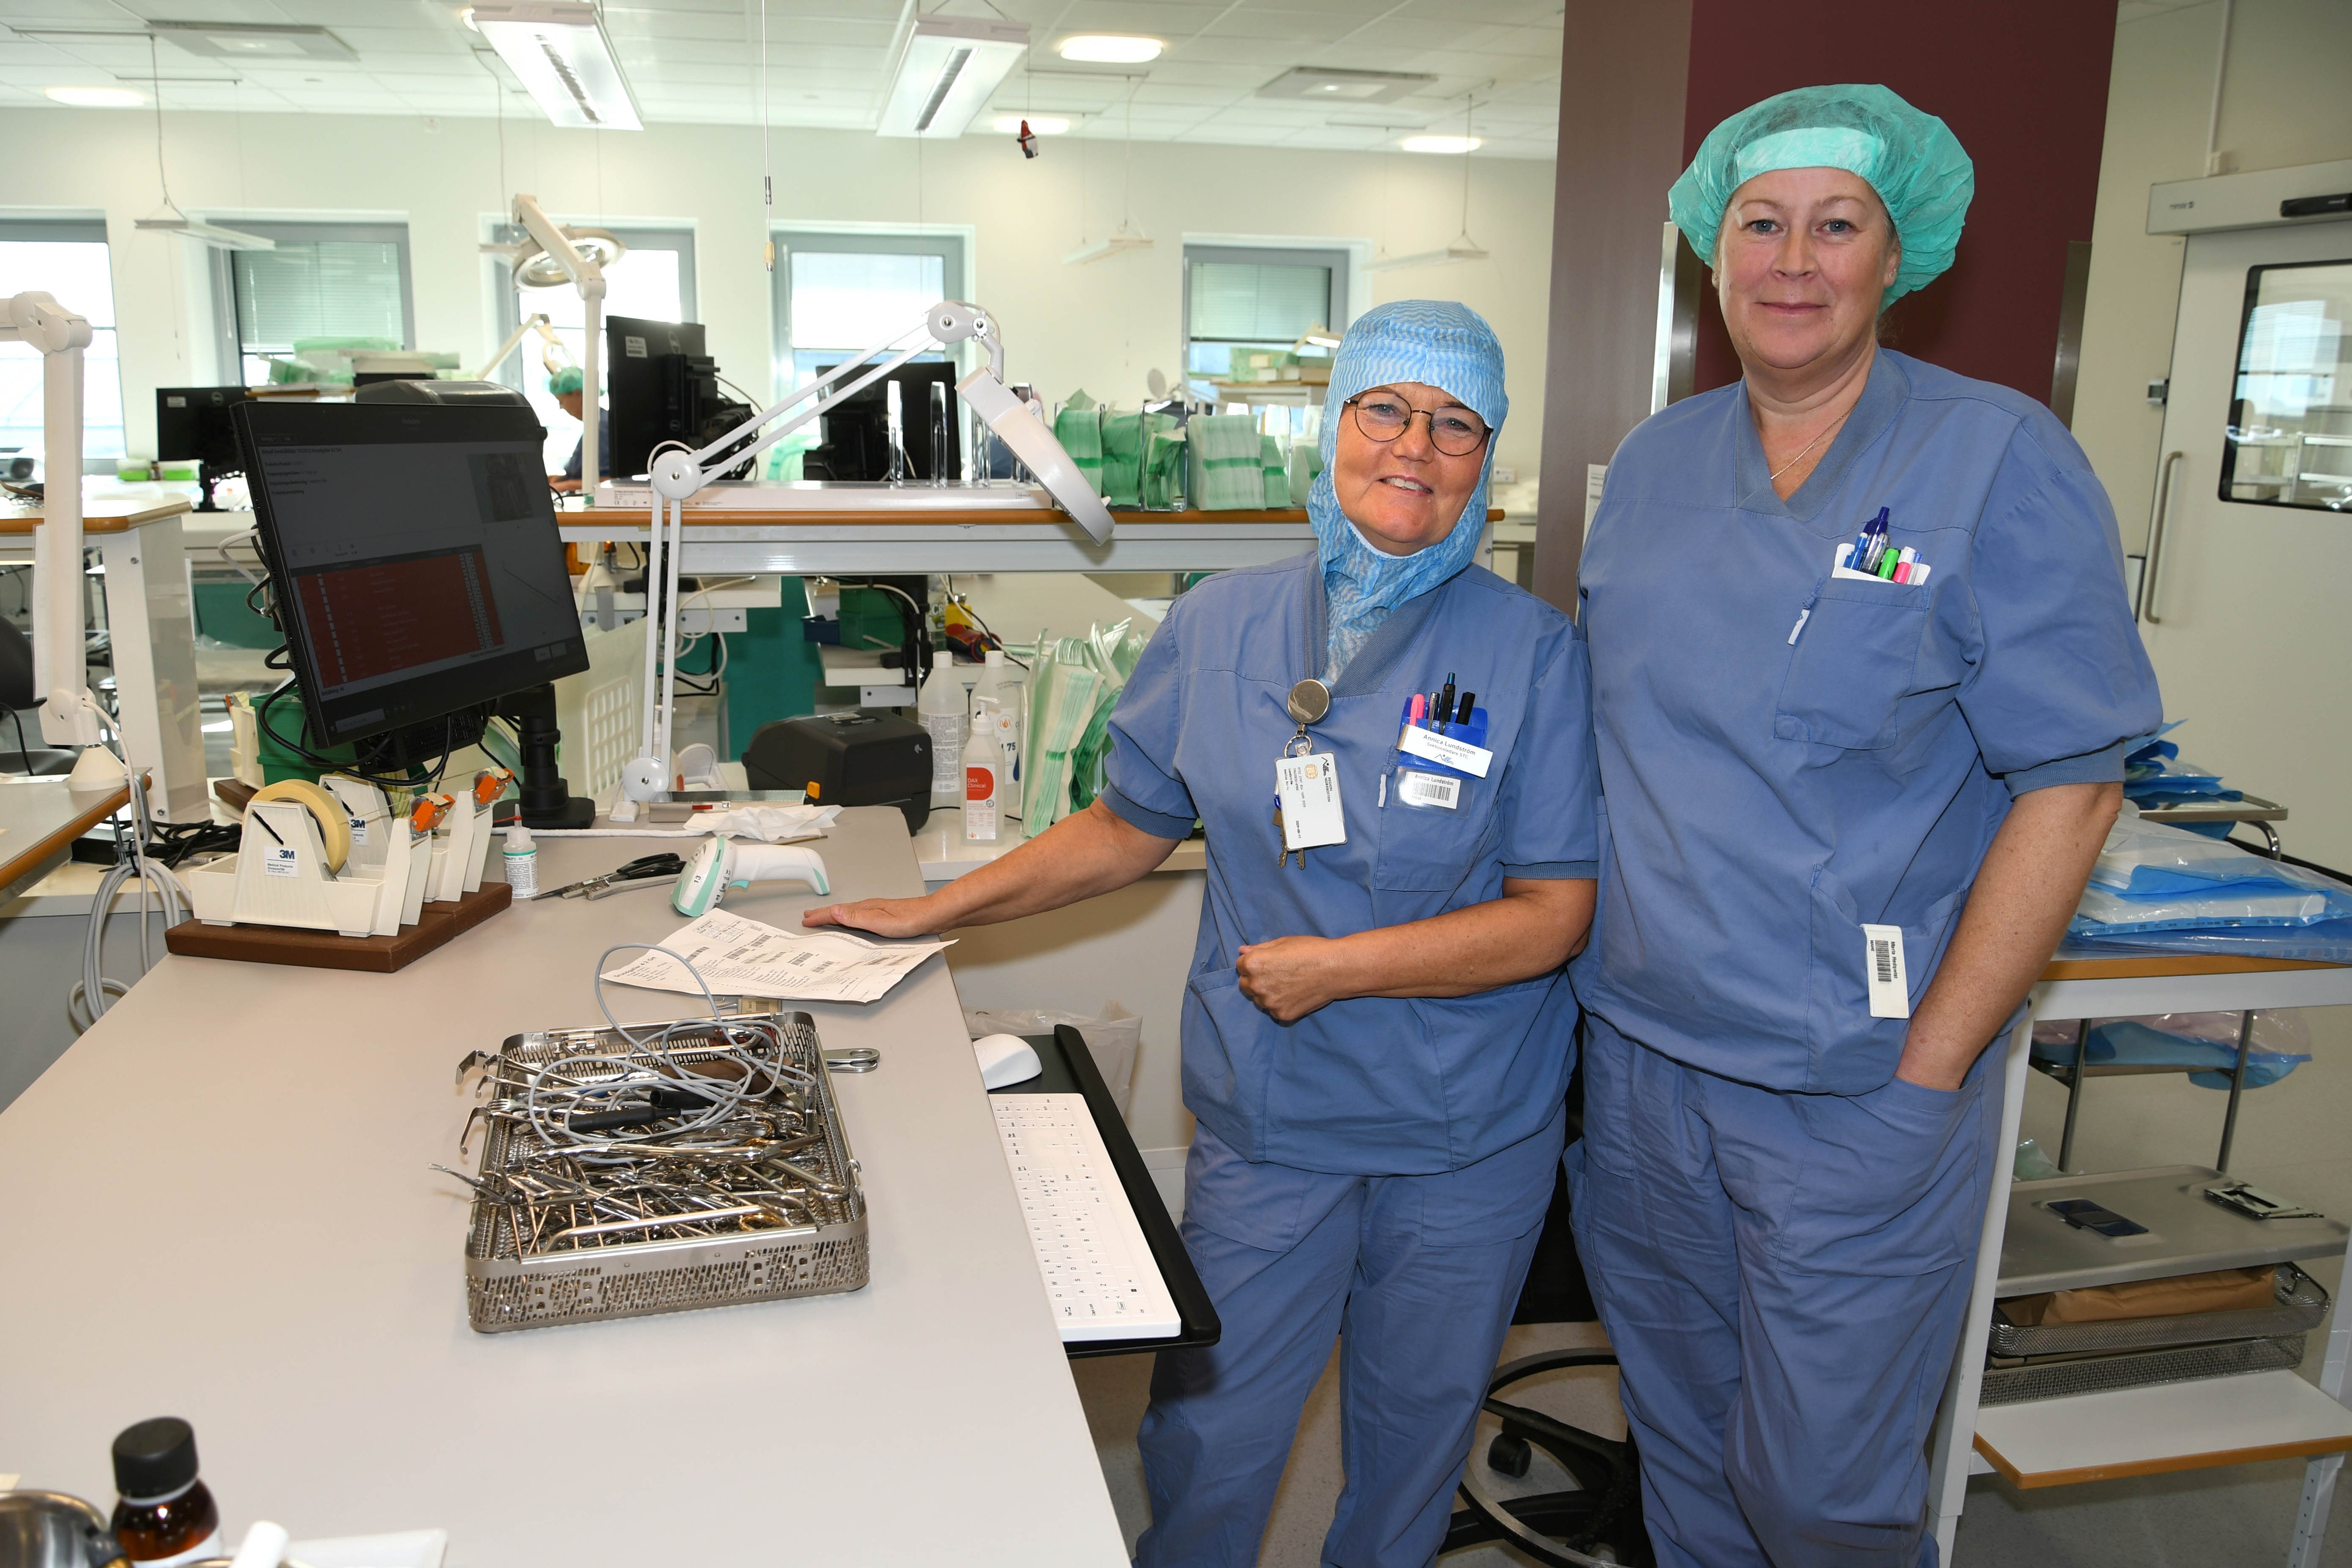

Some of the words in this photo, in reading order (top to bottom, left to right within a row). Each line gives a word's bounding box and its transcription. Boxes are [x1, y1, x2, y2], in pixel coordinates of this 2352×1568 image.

[1007, 742, 1016, 751] 75
[1423, 734, 1443, 745] Annica
[1445, 741, 1476, 755] Lundström
[1427, 742, 1459, 755] Sektionsledare
[1431, 777, 1454, 786] Lundström
[351, 819, 365, 828] 3M
[279, 849, 295, 860] 3M
[694, 875, 701, 883] 13
